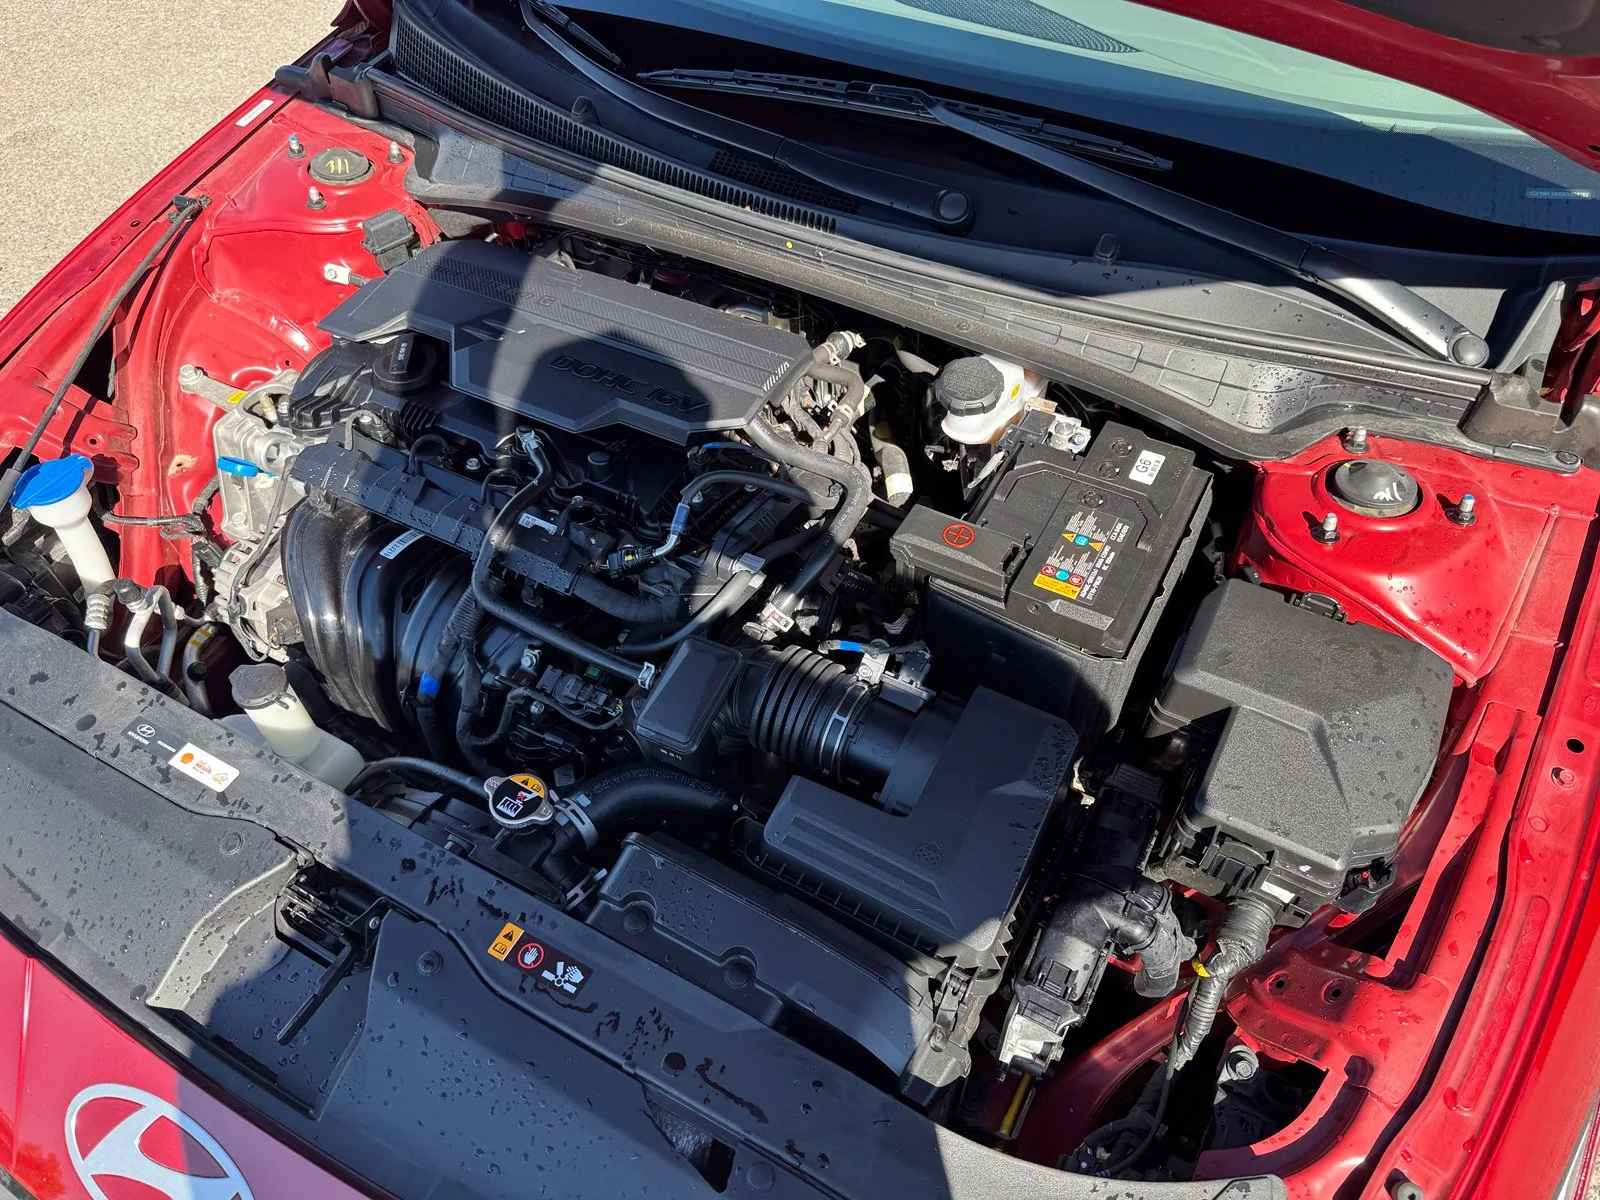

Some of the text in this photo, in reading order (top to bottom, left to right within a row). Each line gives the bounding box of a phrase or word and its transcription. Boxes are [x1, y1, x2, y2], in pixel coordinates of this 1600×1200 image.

[326, 158, 350, 174] 311
[547, 353, 712, 413] DOHC 16V
[1136, 457, 1152, 474] G6
[127, 730, 150, 746] HYUNDAI
